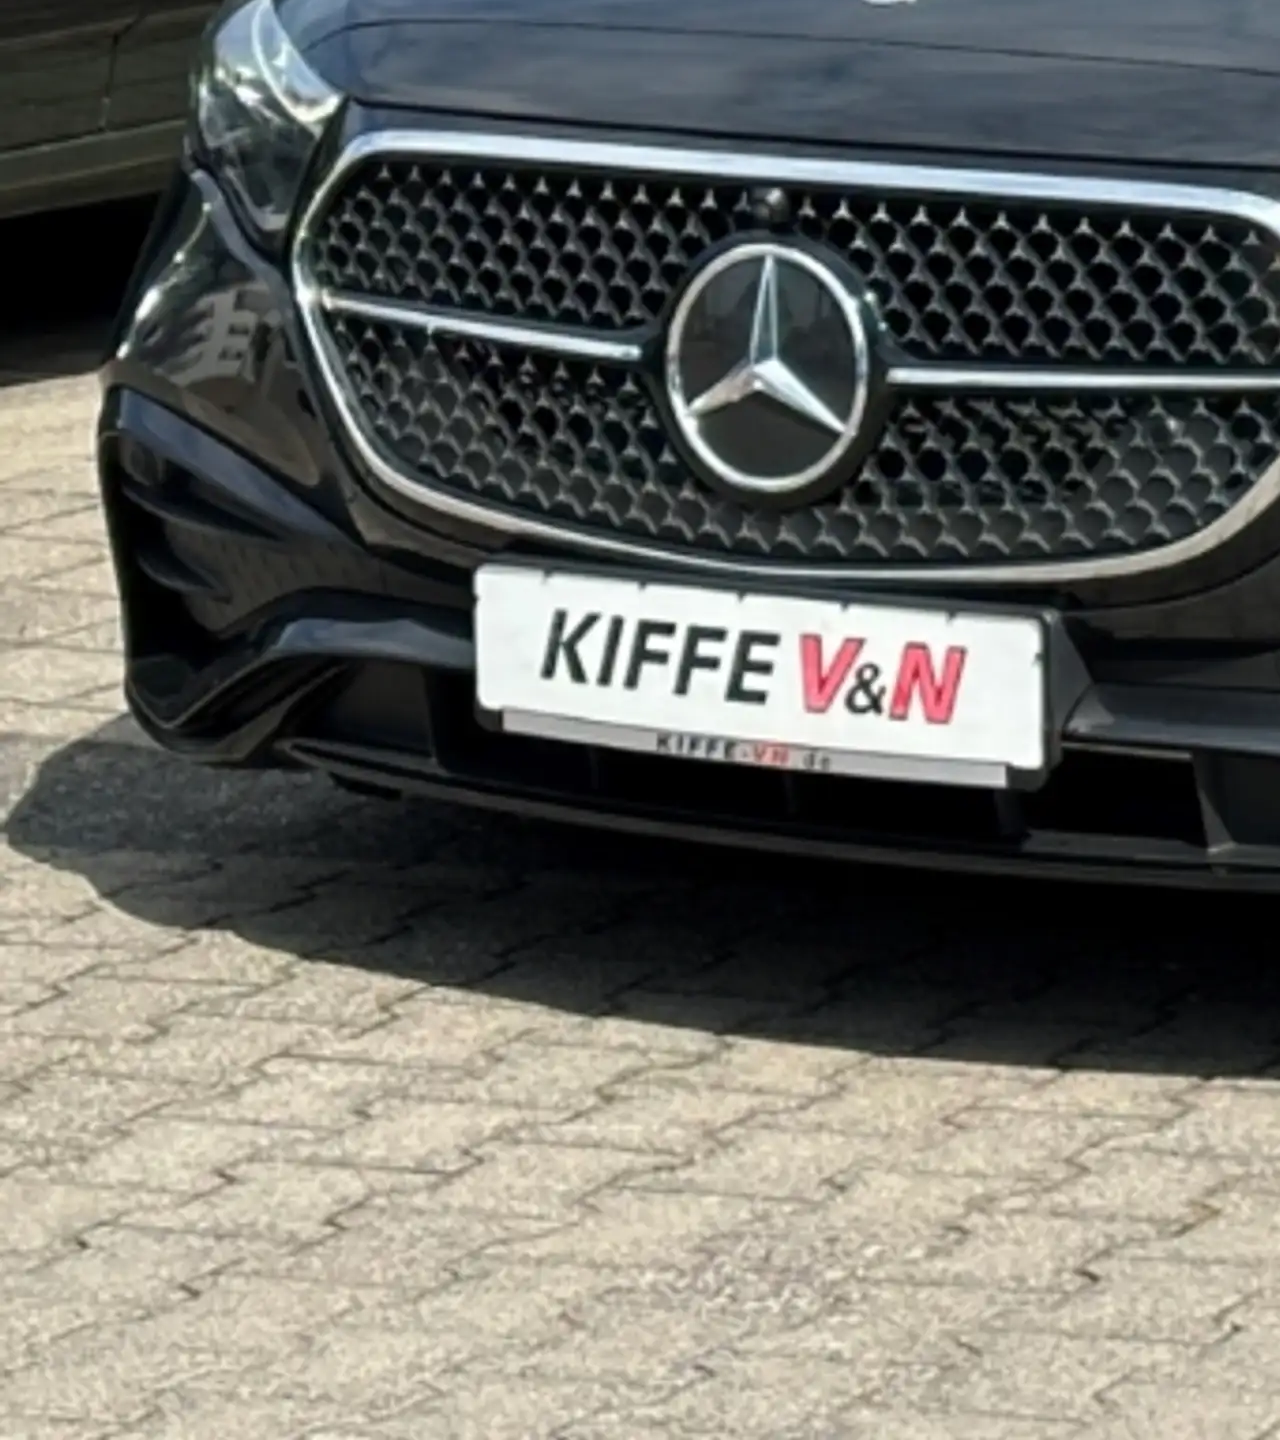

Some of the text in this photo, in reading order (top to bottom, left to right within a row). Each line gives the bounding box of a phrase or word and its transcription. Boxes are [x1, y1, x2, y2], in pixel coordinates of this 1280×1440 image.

[540, 608, 969, 726] KIFFE V&N
[656, 732, 832, 771] KIFFE-VNde
